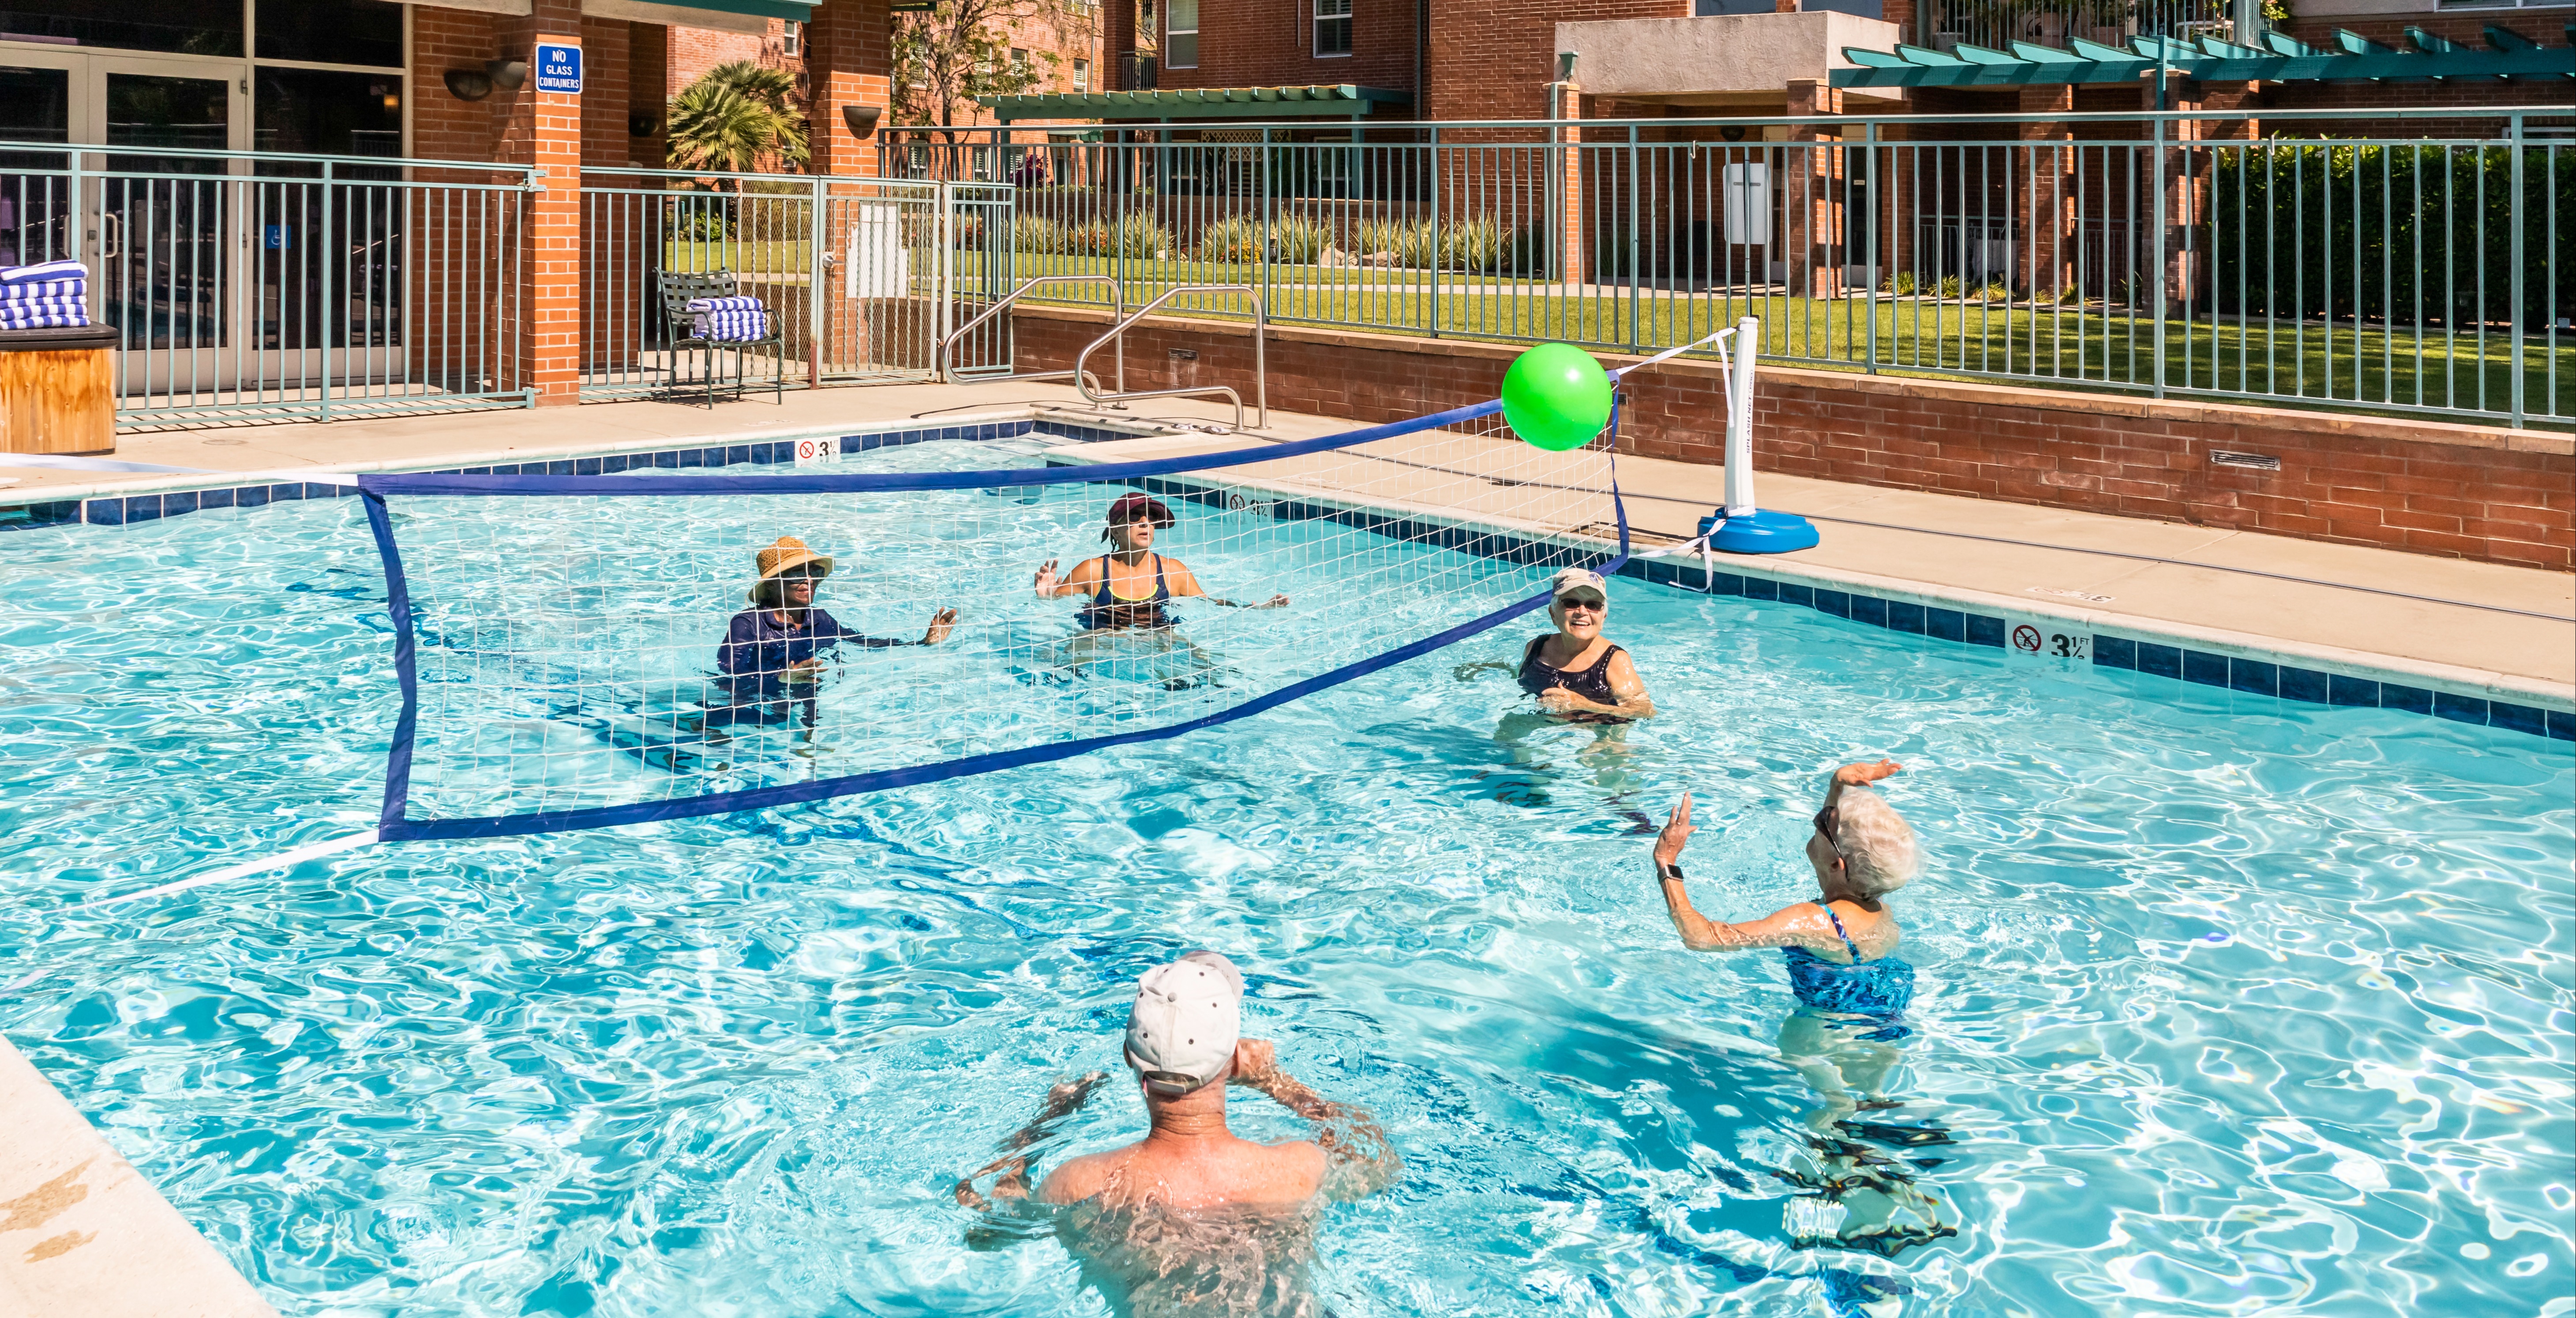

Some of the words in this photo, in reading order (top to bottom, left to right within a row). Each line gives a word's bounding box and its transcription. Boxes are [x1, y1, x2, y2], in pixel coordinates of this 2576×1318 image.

[552, 50, 566, 63] NO
[546, 65, 572, 75] GLASS
[539, 77, 579, 89] CONTAINERS
